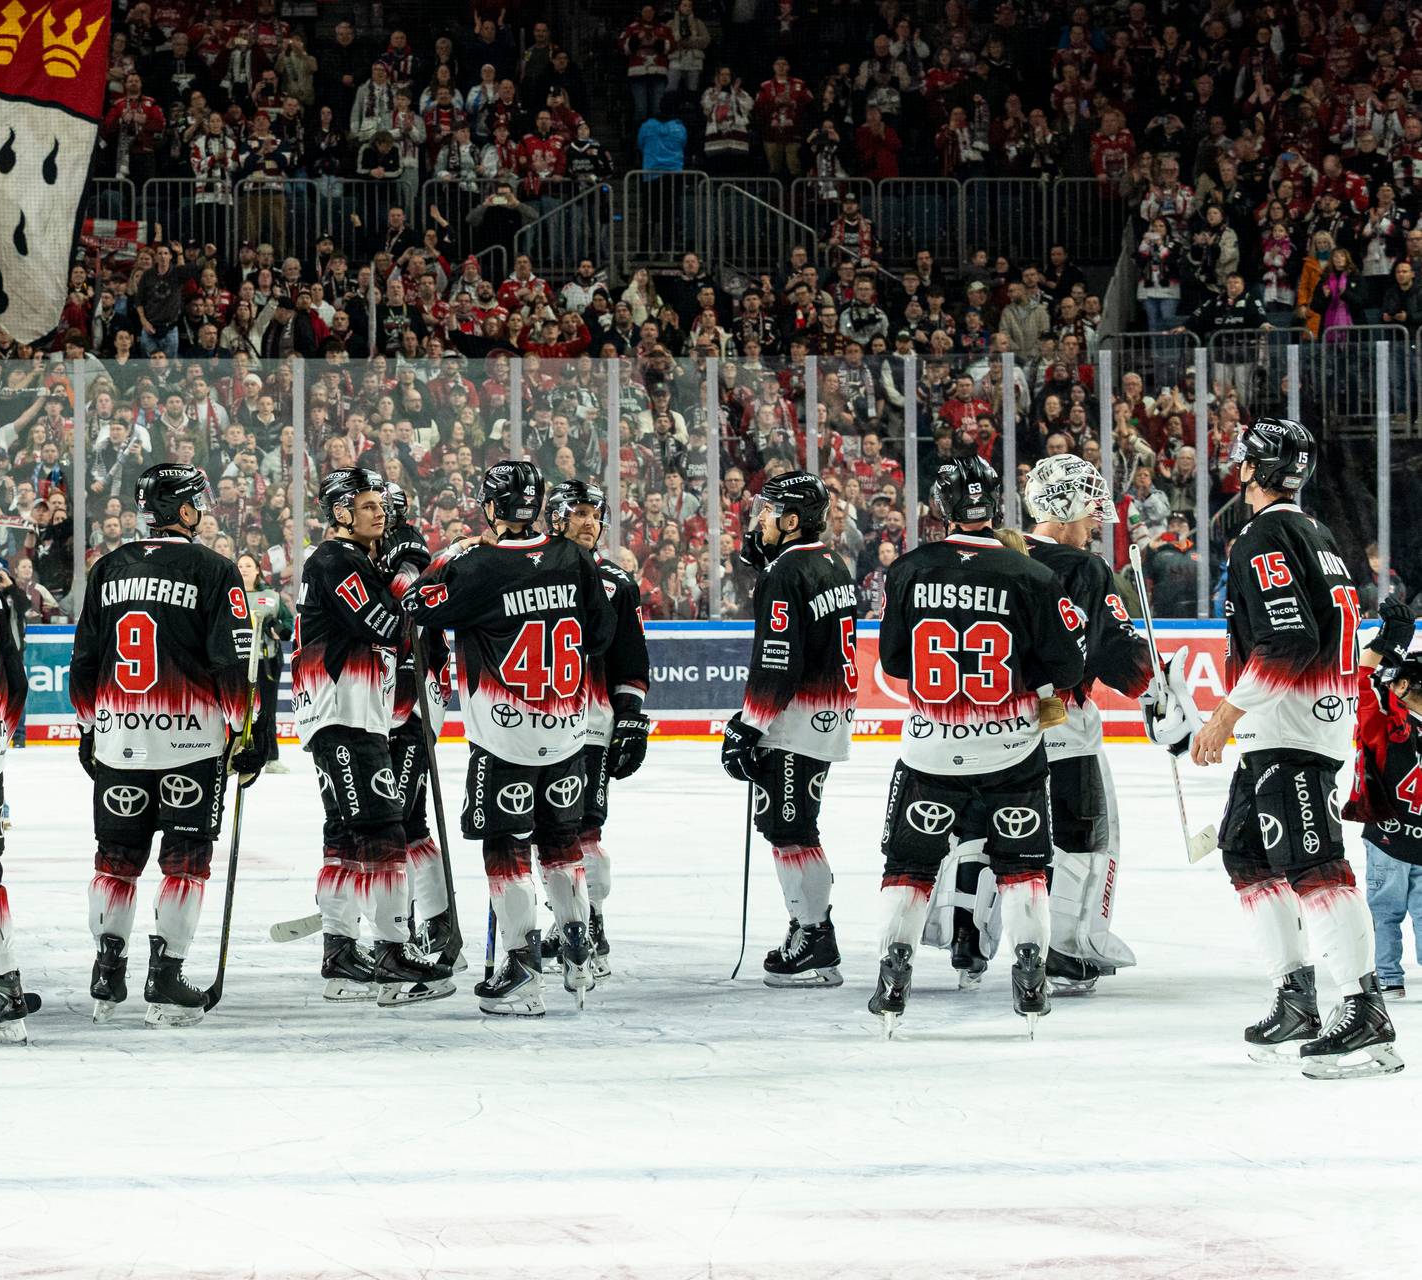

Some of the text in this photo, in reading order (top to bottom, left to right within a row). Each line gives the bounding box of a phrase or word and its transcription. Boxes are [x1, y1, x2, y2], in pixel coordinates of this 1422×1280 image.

[1254, 423, 1289, 436] STETSON
[1298, 451, 1309, 464] 15
[524, 485, 535, 496] 46
[780, 475, 816, 488] STETSON
[968, 483, 982, 493] 63
[1251, 552, 1293, 592] 15
[101, 577, 198, 610] KAMMERER
[228, 587, 248, 619] 9
[335, 571, 370, 613] 17
[502, 584, 578, 617] NIEDENZ
[914, 583, 1010, 615] RUSSELL
[770, 600, 789, 632] 5
[116, 611, 158, 694] 9
[499, 617, 582, 701] 46
[763, 648, 790, 656] TRICORP
[912, 618, 1012, 705] 63
[116, 712, 202, 731] TOYOTA
[617, 720, 651, 730] BAU
[939, 715, 1031, 740] TOYOTA
[399, 745, 417, 790] TOYOTA
[476, 756, 488, 804] TOYOTA
[784, 753, 795, 801] TOYOTA
[211, 775, 222, 829] TOYOTA
[342, 766, 360, 817] TOYOTA
[1293, 771, 1316, 830] TOYOTA
[1101, 858, 1116, 919] BAUER
